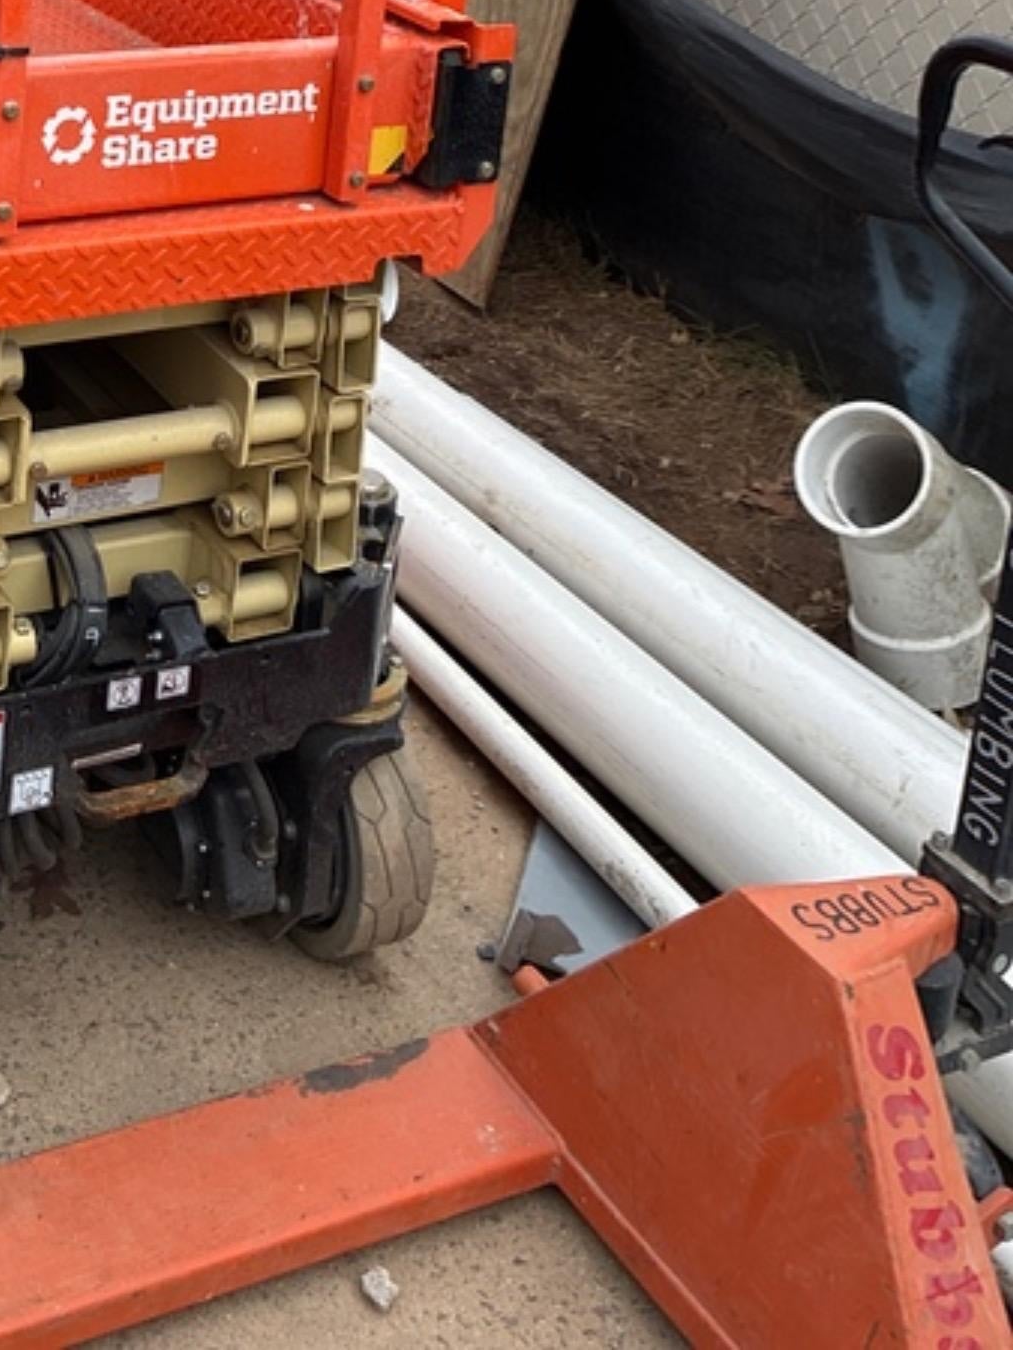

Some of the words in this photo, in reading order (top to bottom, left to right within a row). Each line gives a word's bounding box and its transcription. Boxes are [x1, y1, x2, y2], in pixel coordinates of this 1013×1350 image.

[104, 82, 321, 133] Equipment
[101, 134, 219, 169] Share
[791, 877, 940, 941] STUBBS
